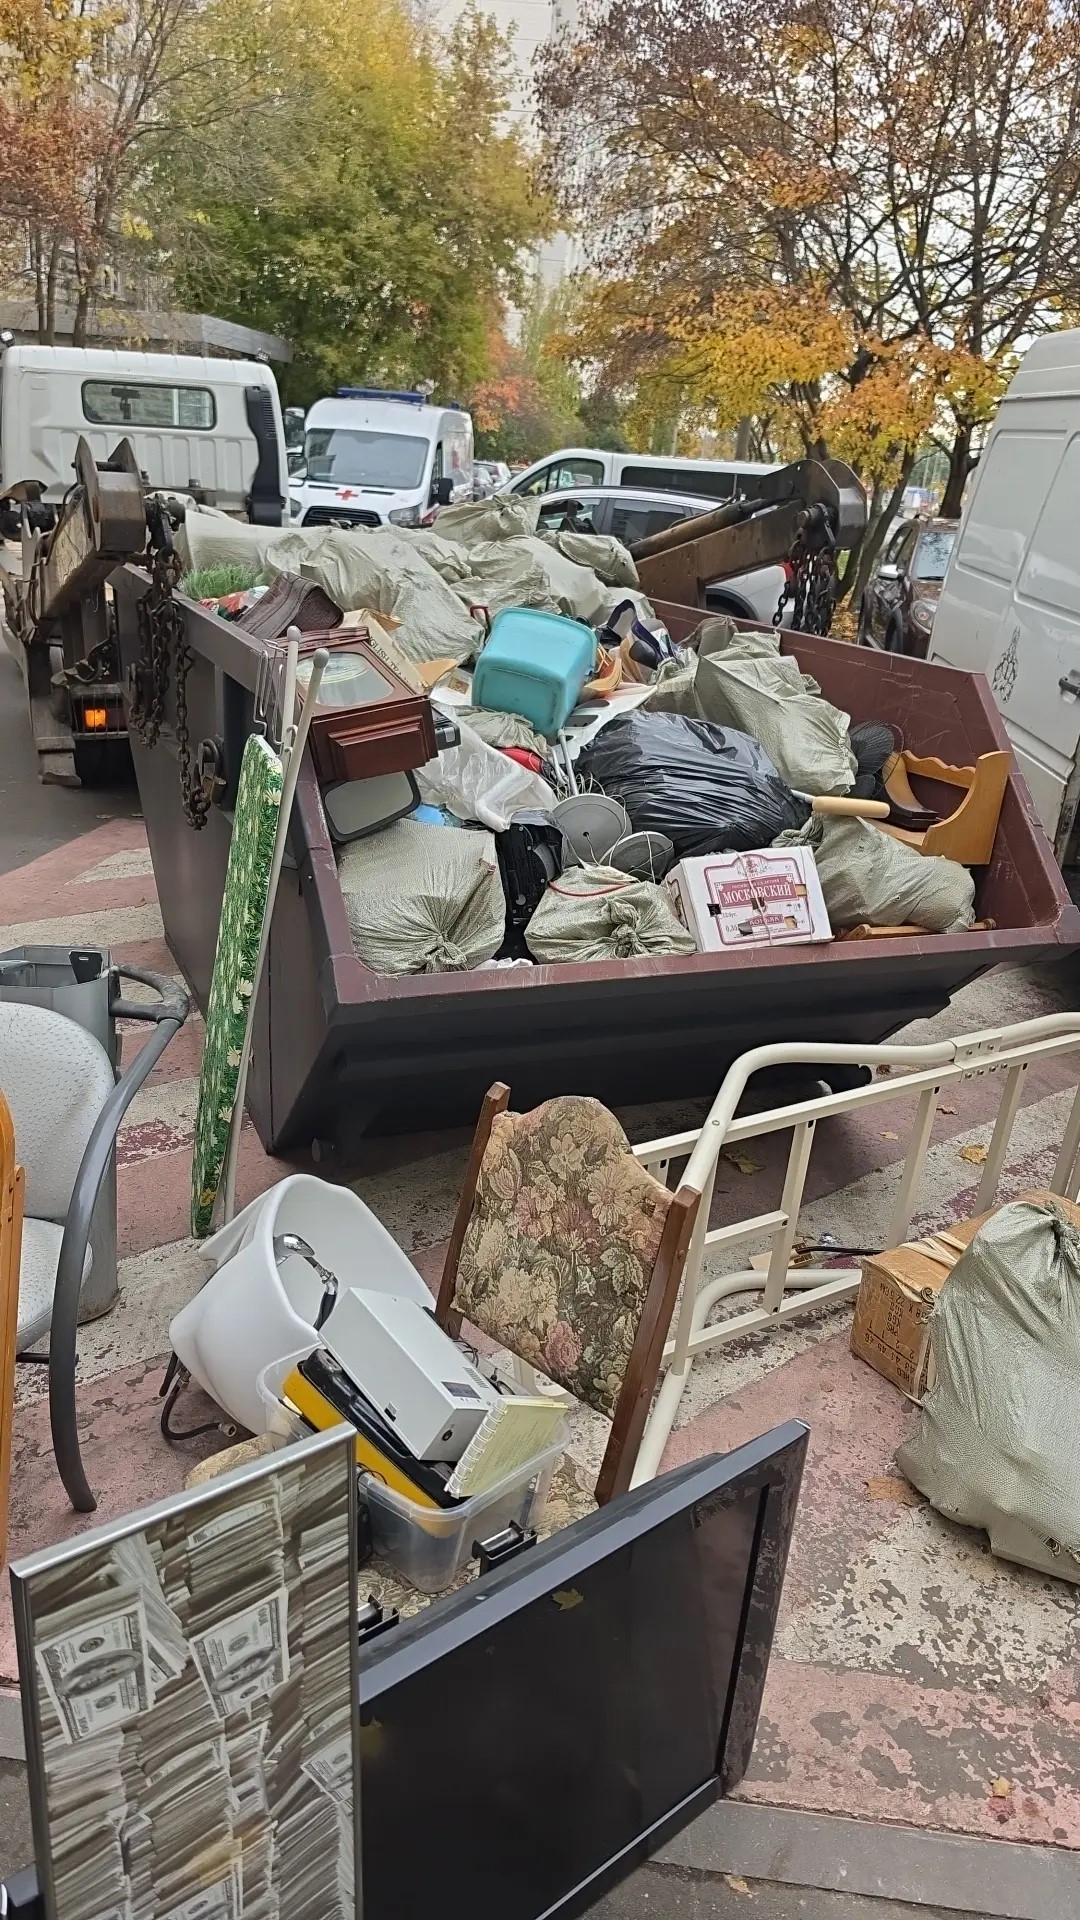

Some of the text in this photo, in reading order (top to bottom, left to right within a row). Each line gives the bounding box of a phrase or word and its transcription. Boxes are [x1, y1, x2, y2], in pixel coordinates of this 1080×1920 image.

[723, 882, 792, 904] МОСКОВСКИЙ
[895, 1340, 900, 1349] 2
[909, 1349, 915, 1359] 2
